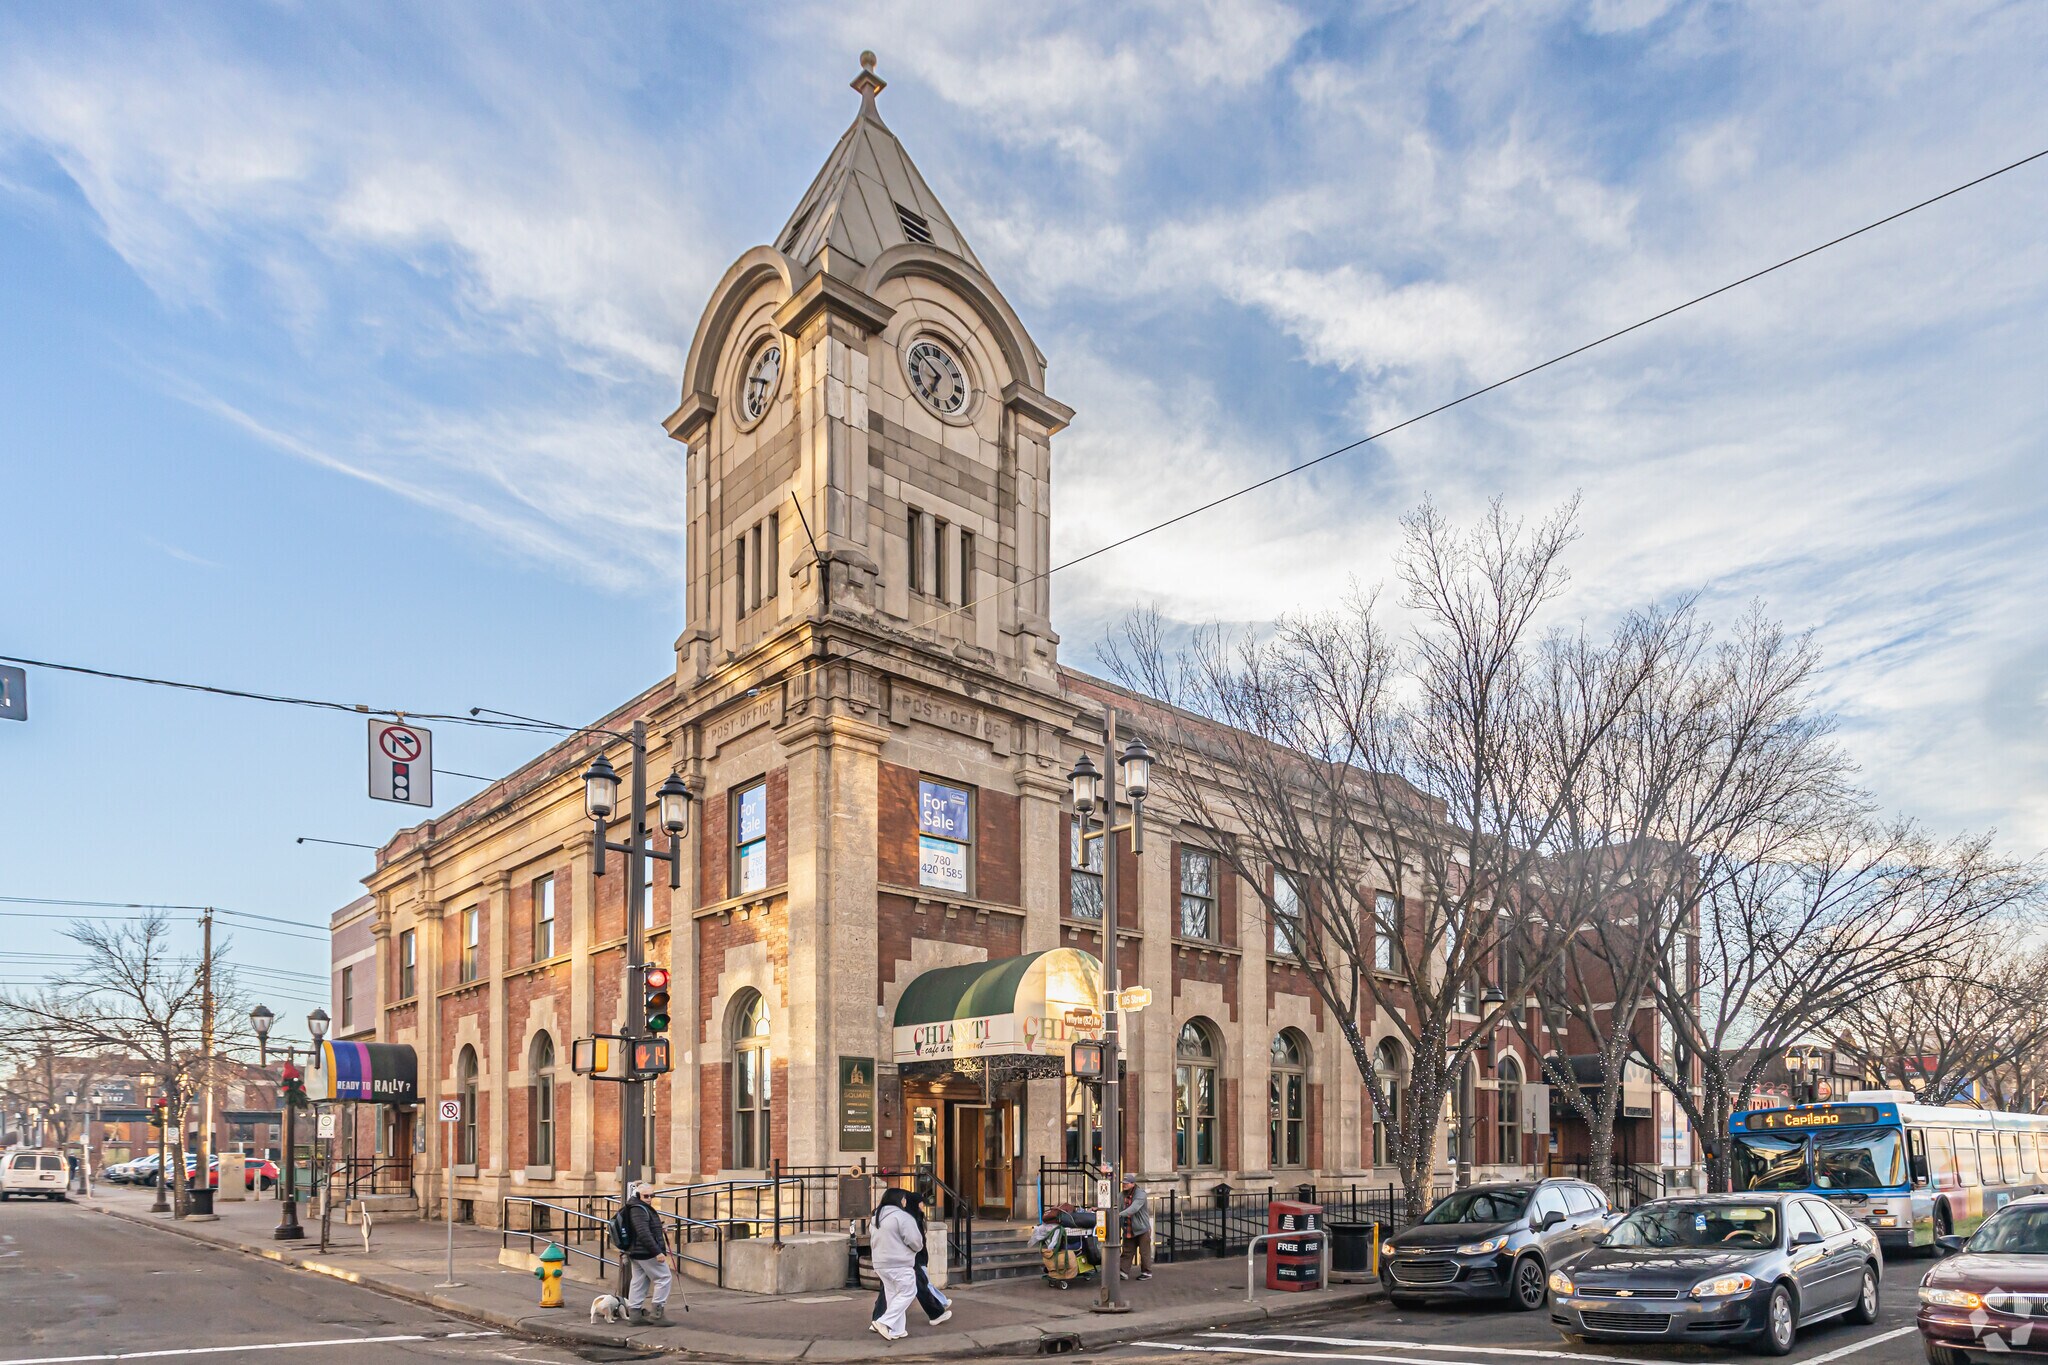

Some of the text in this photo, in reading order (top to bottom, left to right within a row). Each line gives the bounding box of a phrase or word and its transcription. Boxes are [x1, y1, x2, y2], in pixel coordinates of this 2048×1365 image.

[902, 695, 942, 719] POST
[711, 698, 776, 740] POST OFFICE
[741, 802, 757, 816] For
[923, 793, 948, 811] For
[741, 817, 761, 835] Sale
[923, 810, 954, 831] Sale
[933, 854, 951, 866] 780
[921, 863, 963, 879] 420 1585
[913, 1019, 991, 1045] CHIANTI
[337, 1080, 360, 1090] READY
[362, 1081, 371, 1091] TO
[1766, 1112, 1839, 1127] 4 Capilano
[1277, 1242, 1318, 1252] FREE FREE
